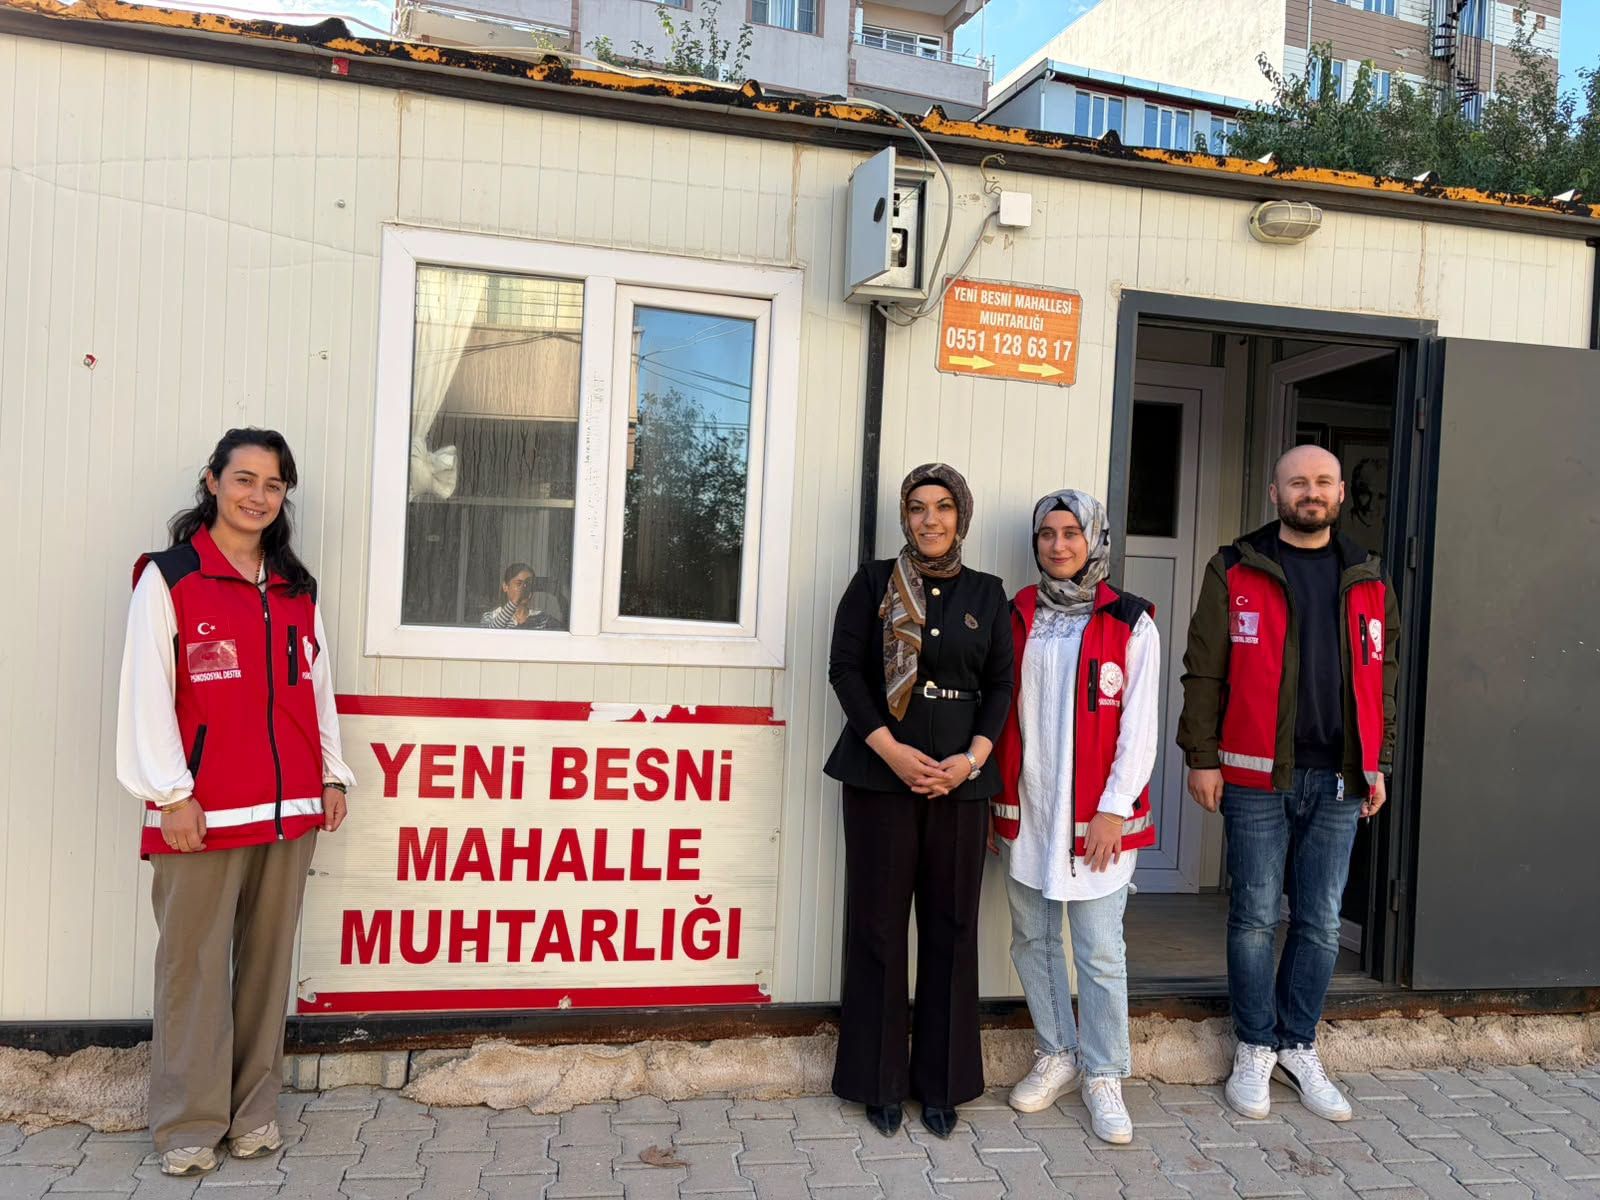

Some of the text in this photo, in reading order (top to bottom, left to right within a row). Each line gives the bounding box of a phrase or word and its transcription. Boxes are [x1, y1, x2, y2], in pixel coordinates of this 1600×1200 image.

[954, 286, 1072, 315] YENİ BESNİ MAHALLESİ
[980, 311, 1044, 331] MUHTARLIĞI
[946, 327, 1072, 361] 0551 128 63 17
[397, 827, 702, 881] MAHALLE
[340, 895, 742, 965] MUHTARLIĞI
